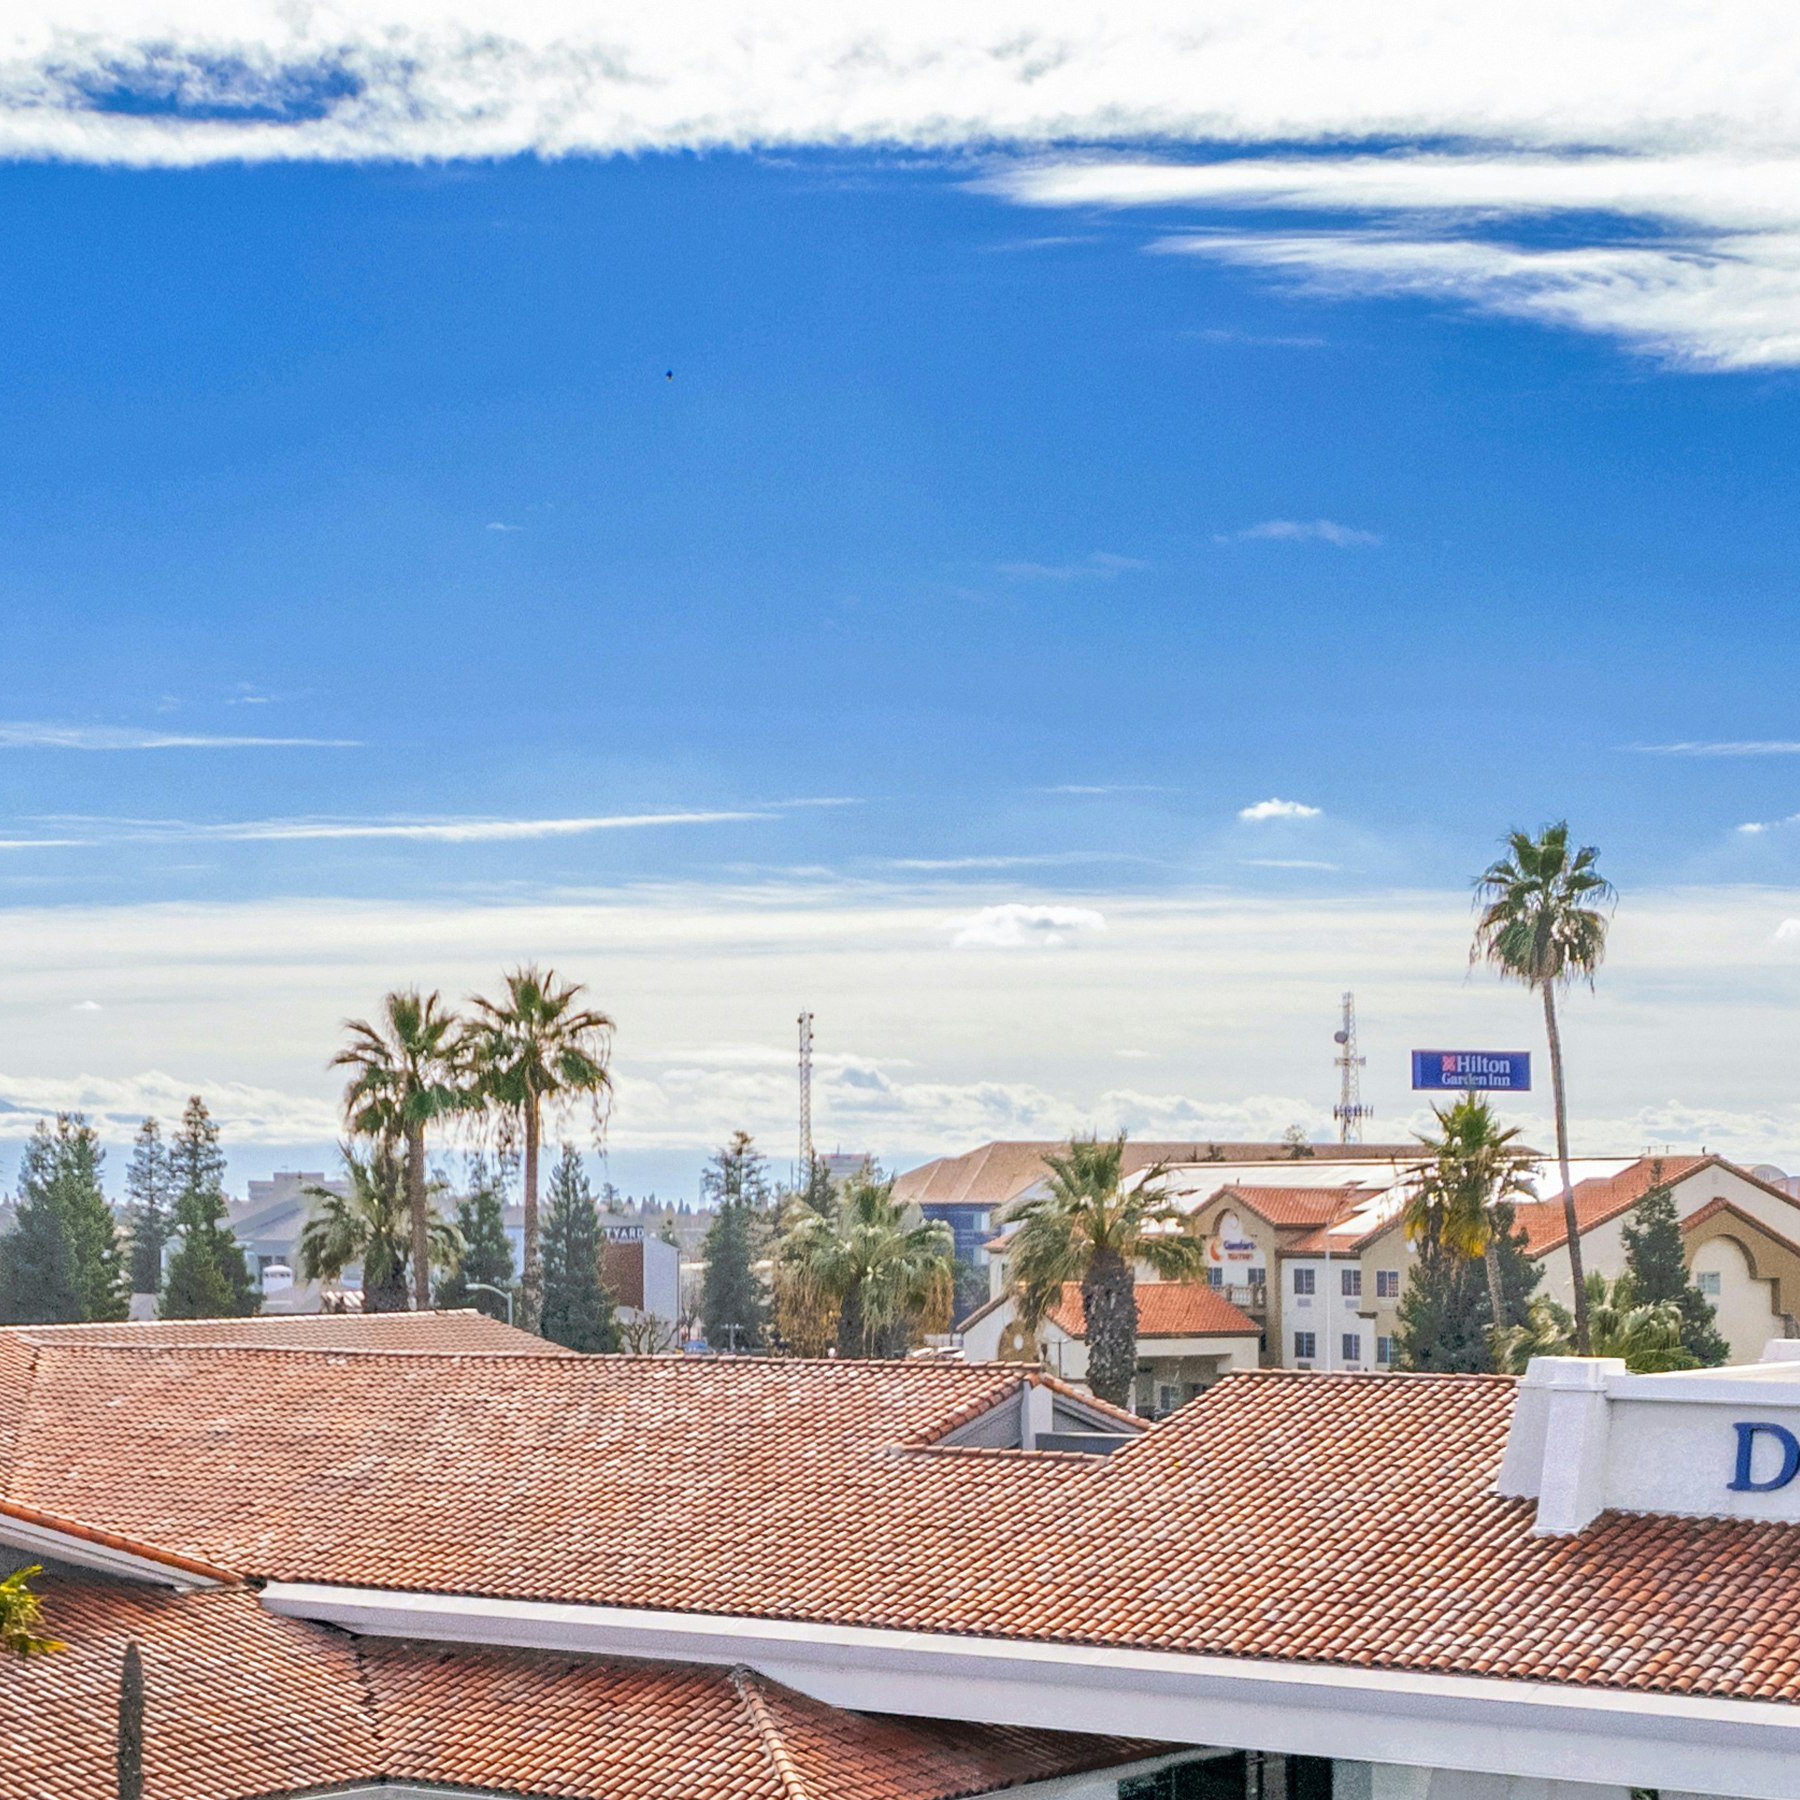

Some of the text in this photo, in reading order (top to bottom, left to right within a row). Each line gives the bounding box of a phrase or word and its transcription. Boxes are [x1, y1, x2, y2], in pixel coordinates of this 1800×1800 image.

[1456, 1055, 1511, 1074] Hilton
[1441, 1072, 1511, 1086] Garden Inn
